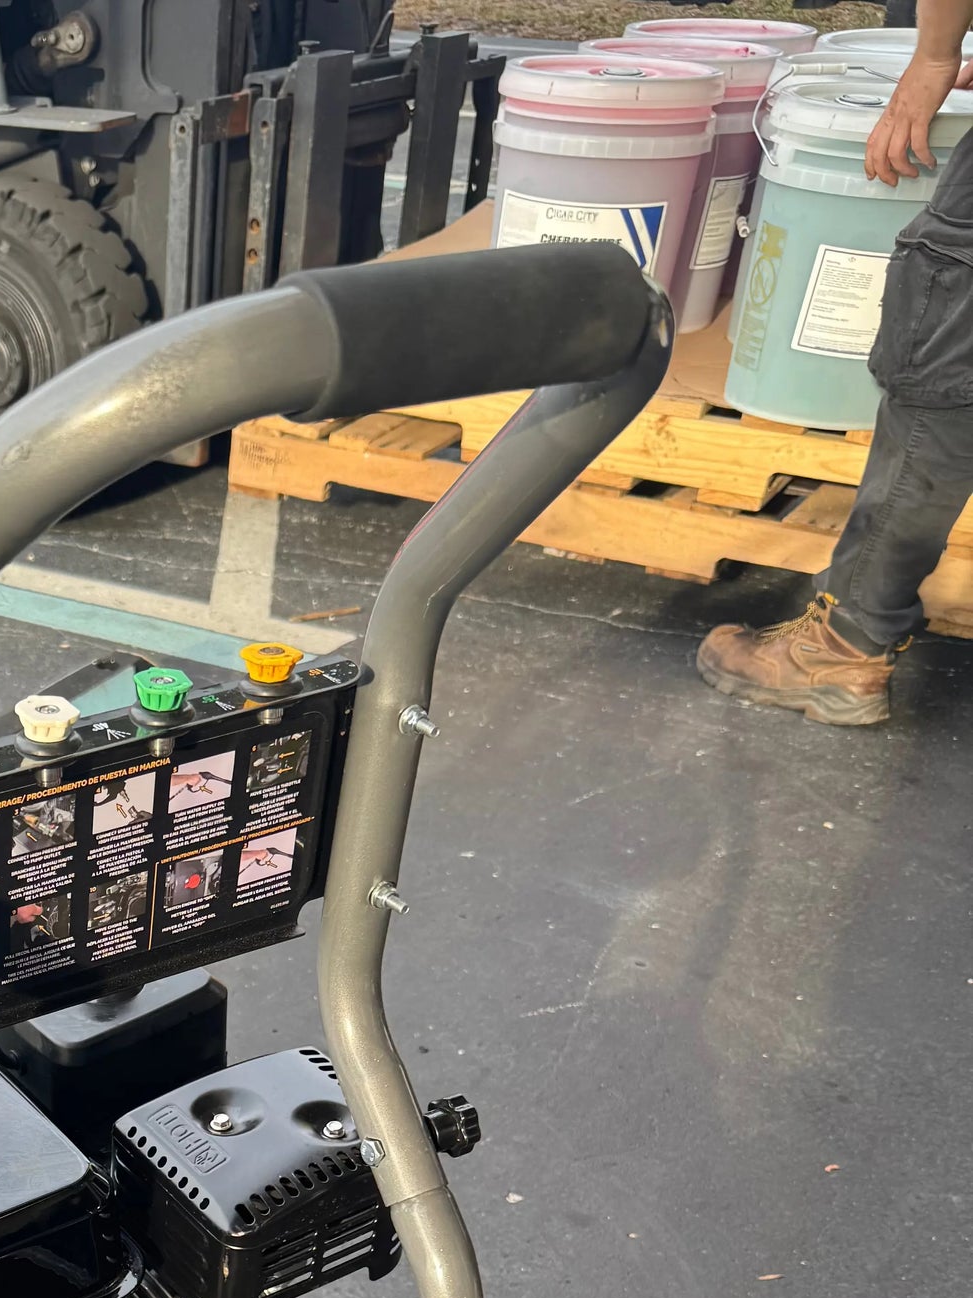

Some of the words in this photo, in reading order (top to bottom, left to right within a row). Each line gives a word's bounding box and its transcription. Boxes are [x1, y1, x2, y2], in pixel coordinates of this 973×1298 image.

[27, 780, 87, 800] PROCEDIMIENTO
[100, 769, 127, 781] PUESTA
[128, 766, 138, 774] EN
[139, 758, 170, 771] MARCHA
[7, 854, 29, 864] CONNECT
[30, 855, 43, 863] PUMP
[10, 865, 35, 876] BRANCHER
[7, 884, 33, 895] CONECTAR
[41, 874, 67, 886] MANGUERA
[10, 892, 22, 900] ALTA
